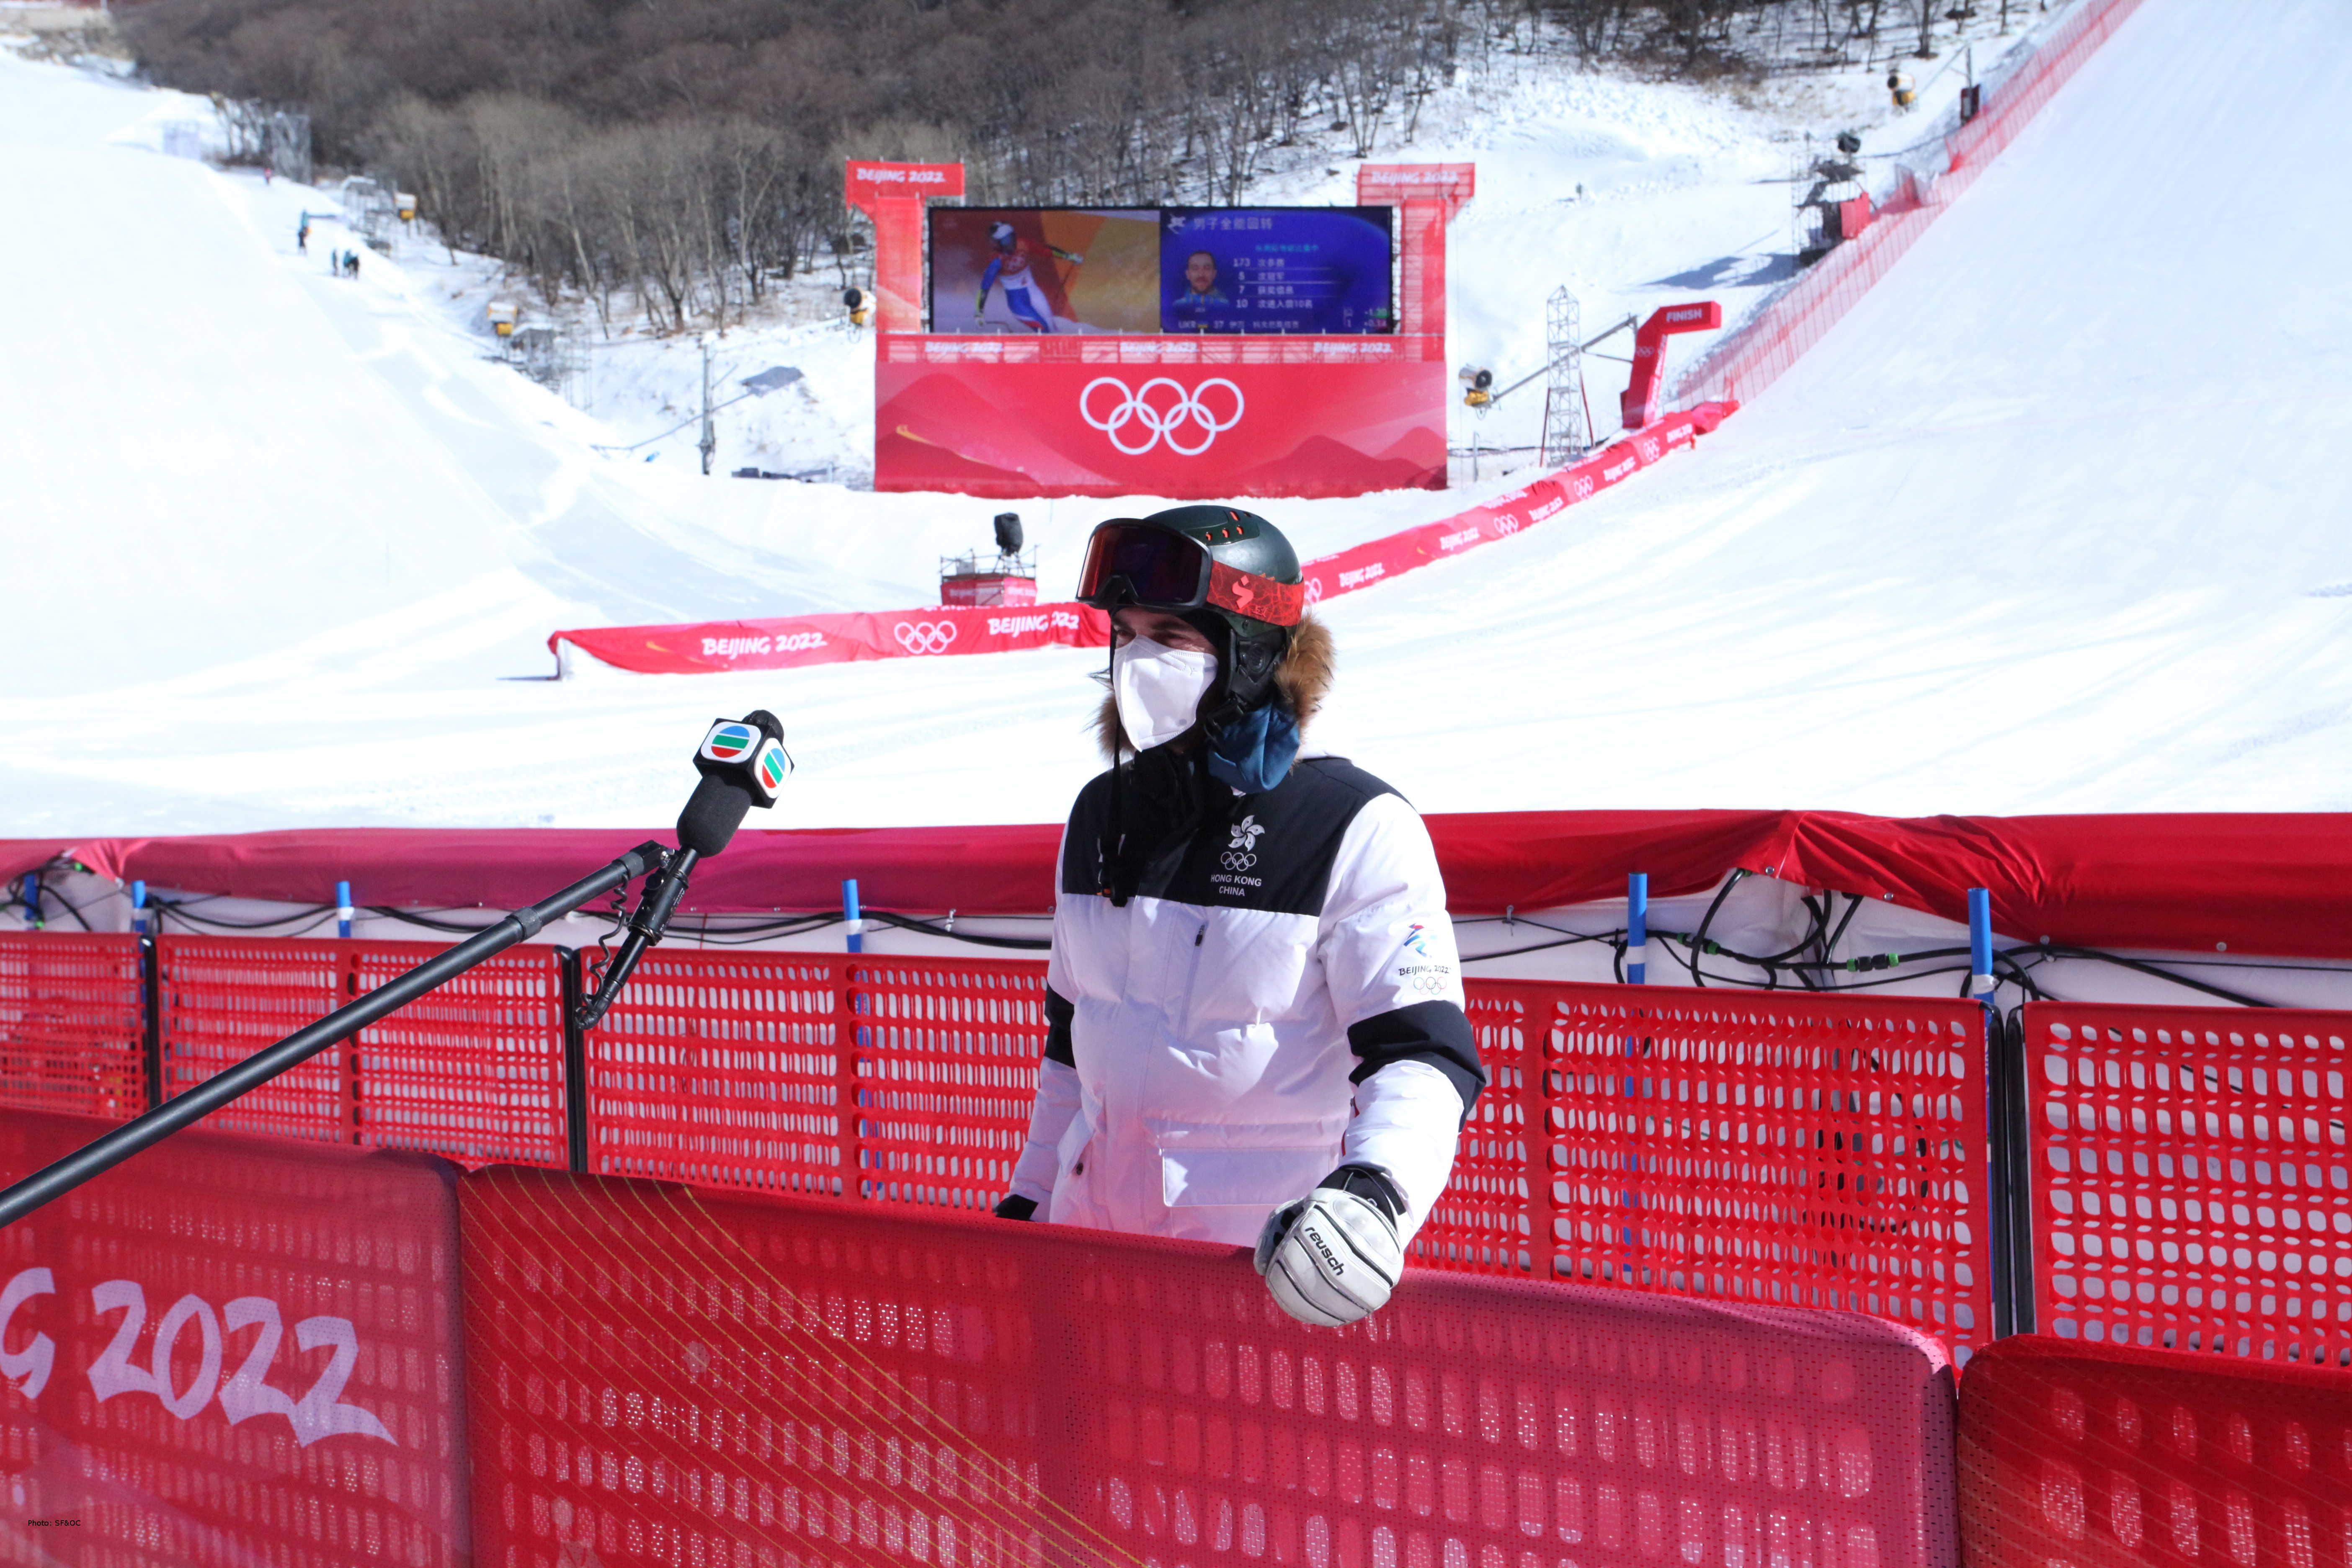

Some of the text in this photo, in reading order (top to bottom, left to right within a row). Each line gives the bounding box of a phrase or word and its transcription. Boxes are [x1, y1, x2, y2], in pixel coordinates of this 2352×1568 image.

[857, 168, 946, 184] BEIJING 2022
[1371, 171, 1459, 186] BEIJING 2022
[1236, 299, 1248, 308] 10
[1666, 308, 1702, 322] FINISH
[1314, 342, 1393, 356] BEIJING 2022
[987, 614, 1048, 637] BEIJING
[701, 632, 828, 660] BEIJING 2022
[1234, 875, 1262, 887] KONG
[1219, 886, 1245, 896] CHINA
[1398, 965, 1449, 976] BEIJING 2022
[1305, 1227, 1344, 1276] reusch
[86, 1279, 399, 1448] 2022
